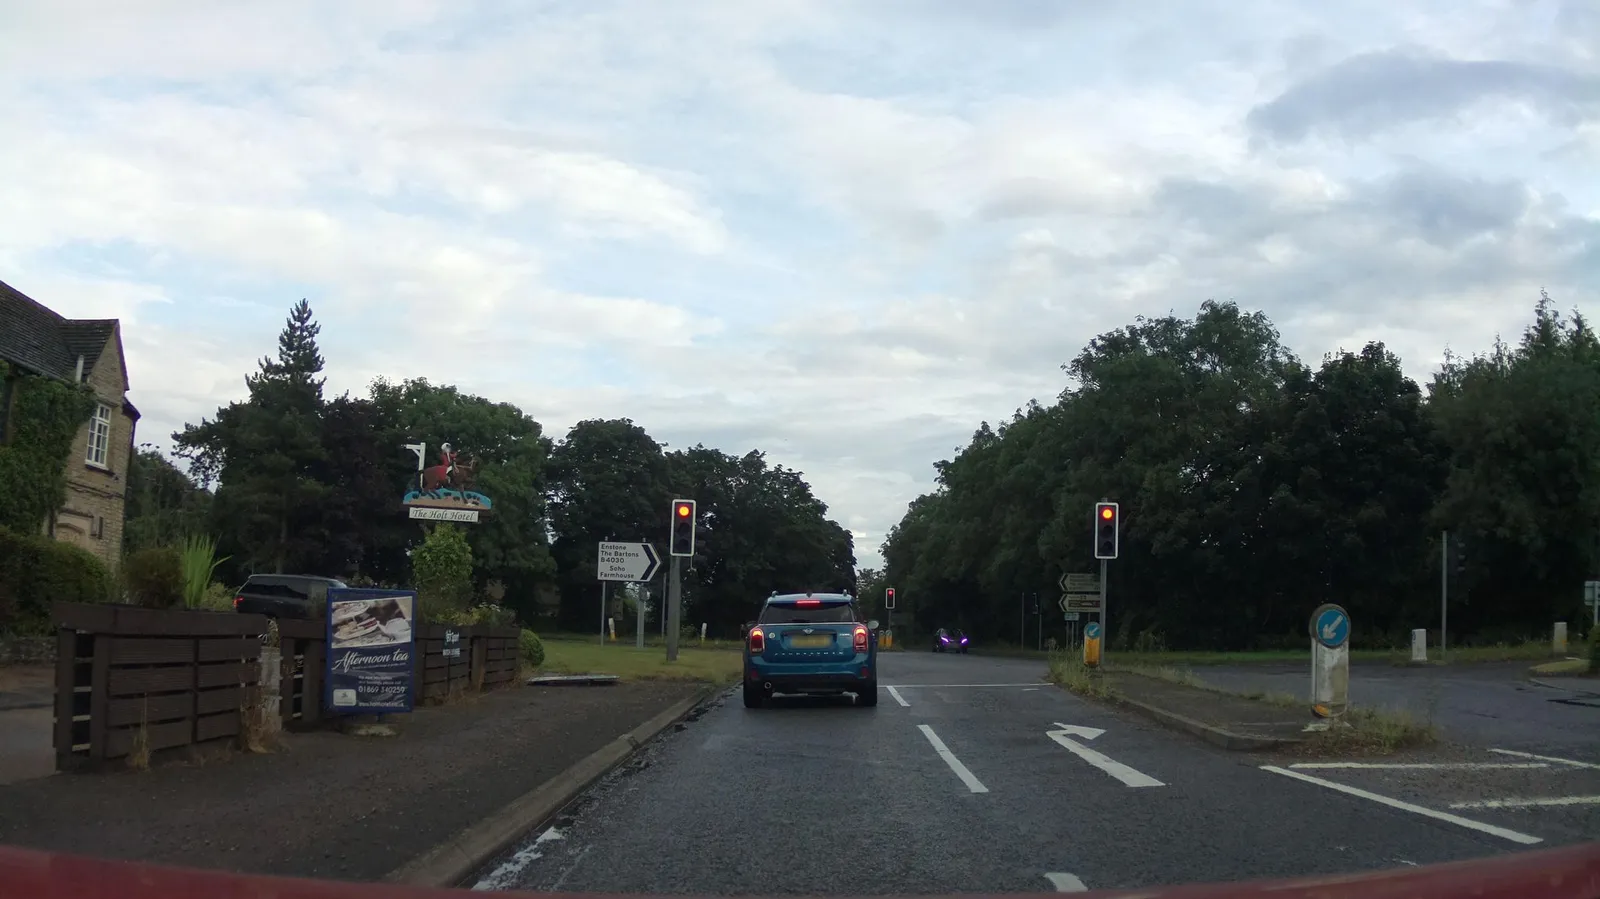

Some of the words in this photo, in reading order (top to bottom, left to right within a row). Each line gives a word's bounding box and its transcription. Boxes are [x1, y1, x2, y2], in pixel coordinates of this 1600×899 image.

[412, 508, 427, 518] The
[429, 509, 447, 519] Holt
[448, 510, 475, 521] Hotel
[331, 650, 391, 673] Afternoon
[392, 648, 409, 662] tea
[358, 685, 379, 693] 01869
